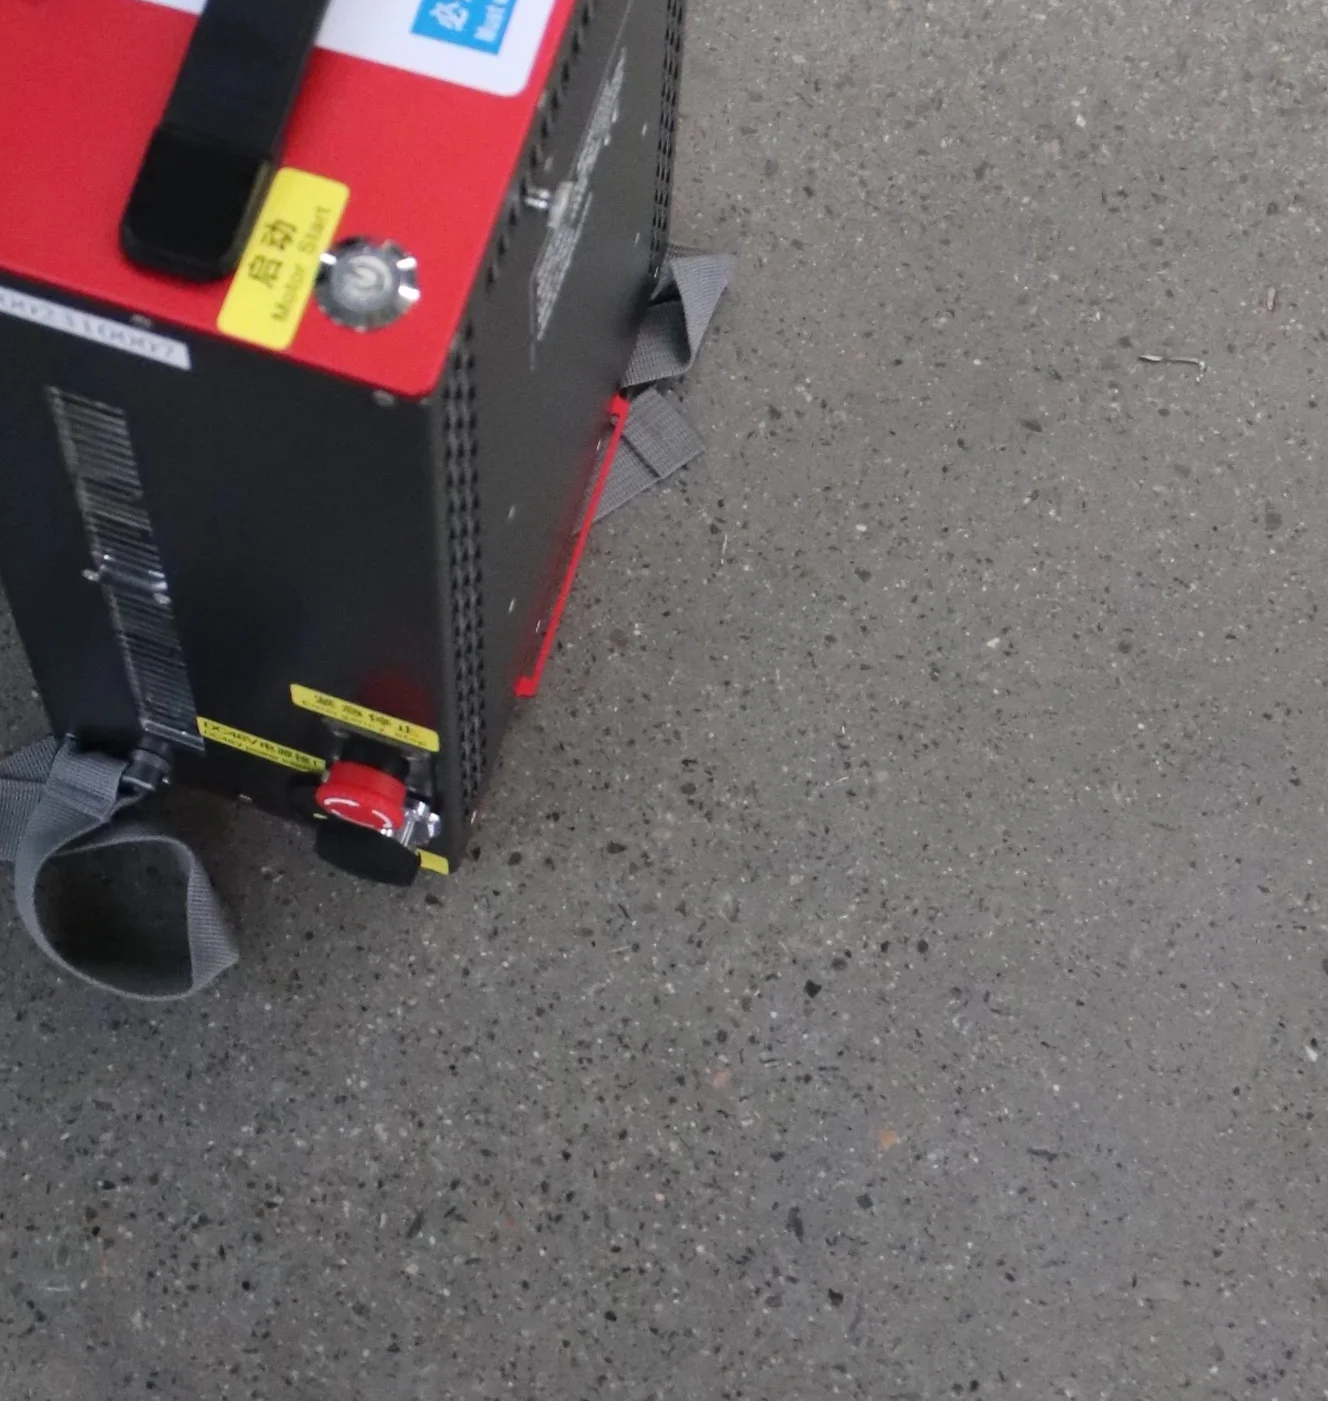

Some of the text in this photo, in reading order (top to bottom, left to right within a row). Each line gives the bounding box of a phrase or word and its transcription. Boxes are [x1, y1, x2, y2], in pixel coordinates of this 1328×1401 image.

[474, 4, 506, 43] Must
[248, 218, 298, 289] 启动
[271, 205, 332, 322] Motor Start
